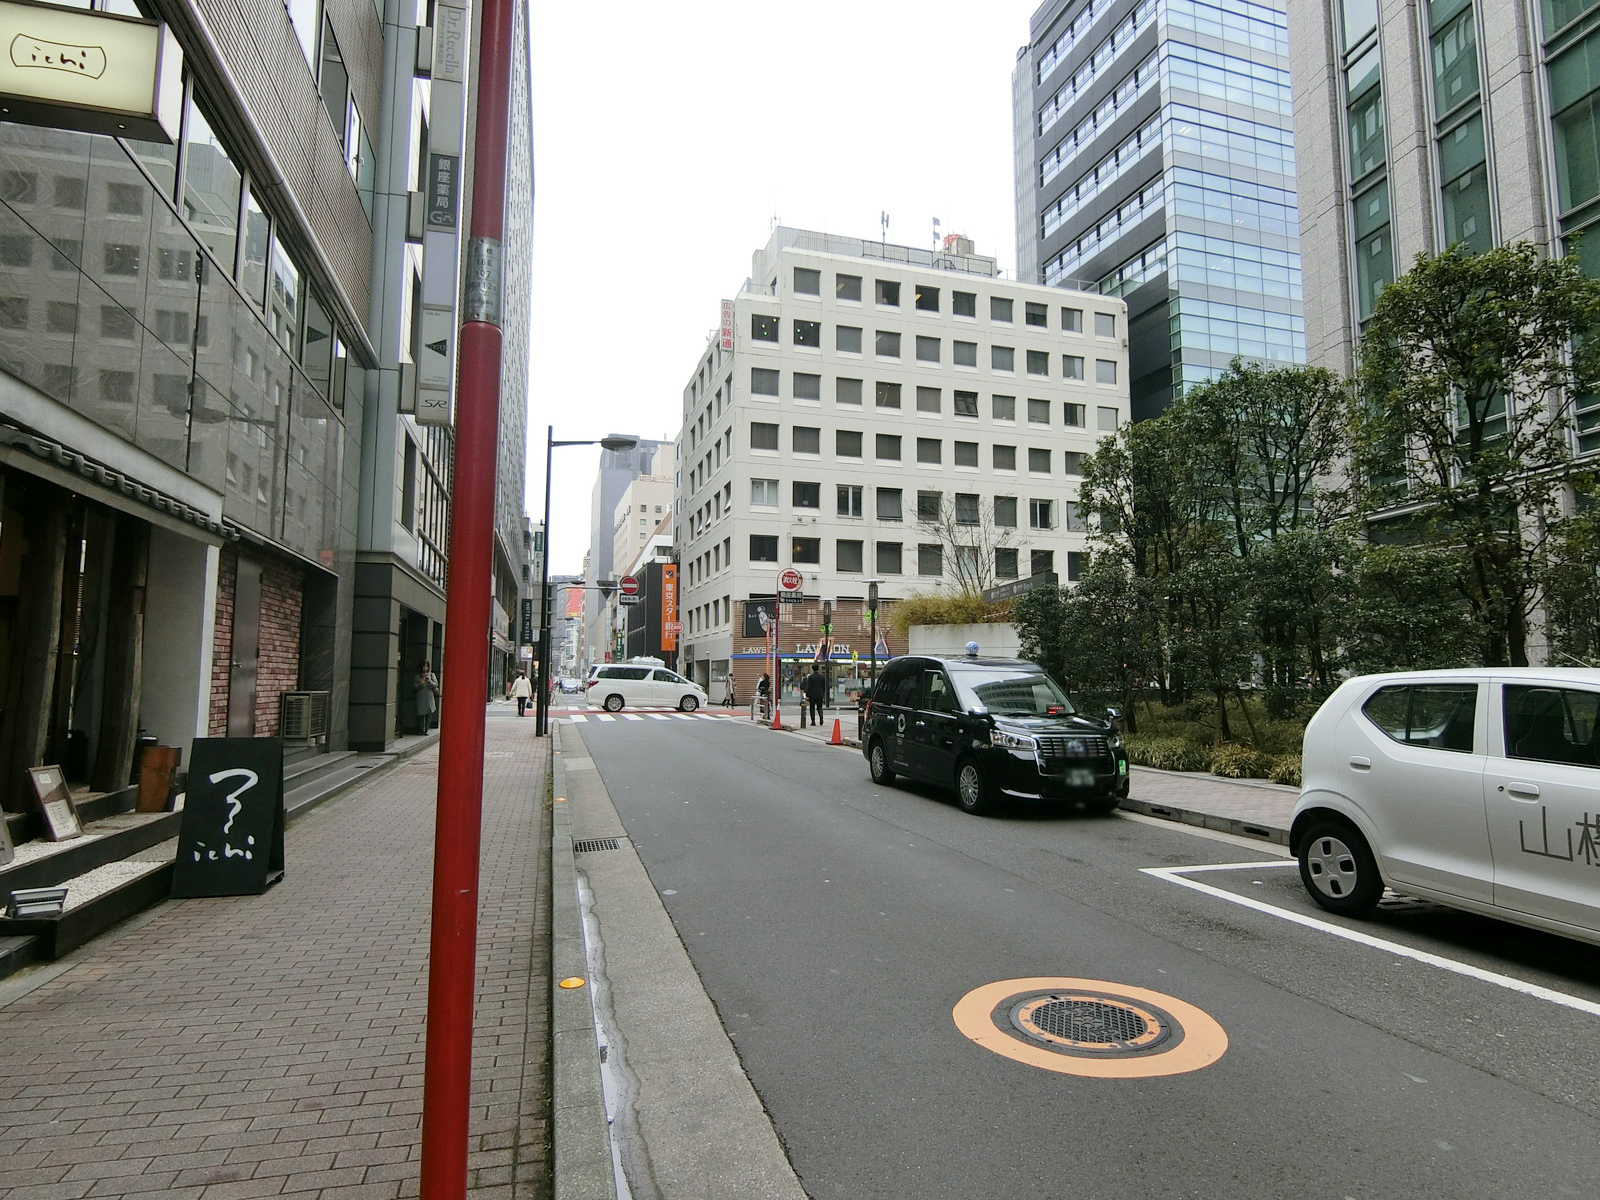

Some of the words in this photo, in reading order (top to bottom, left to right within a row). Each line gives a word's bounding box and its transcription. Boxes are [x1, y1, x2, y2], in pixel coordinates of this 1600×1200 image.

[436, 159, 451, 209] 銀座薬局
[722, 302, 732, 348] 広告の新通
[665, 583, 675, 639] 東京スター銀行
[795, 644, 850, 653] LAON
